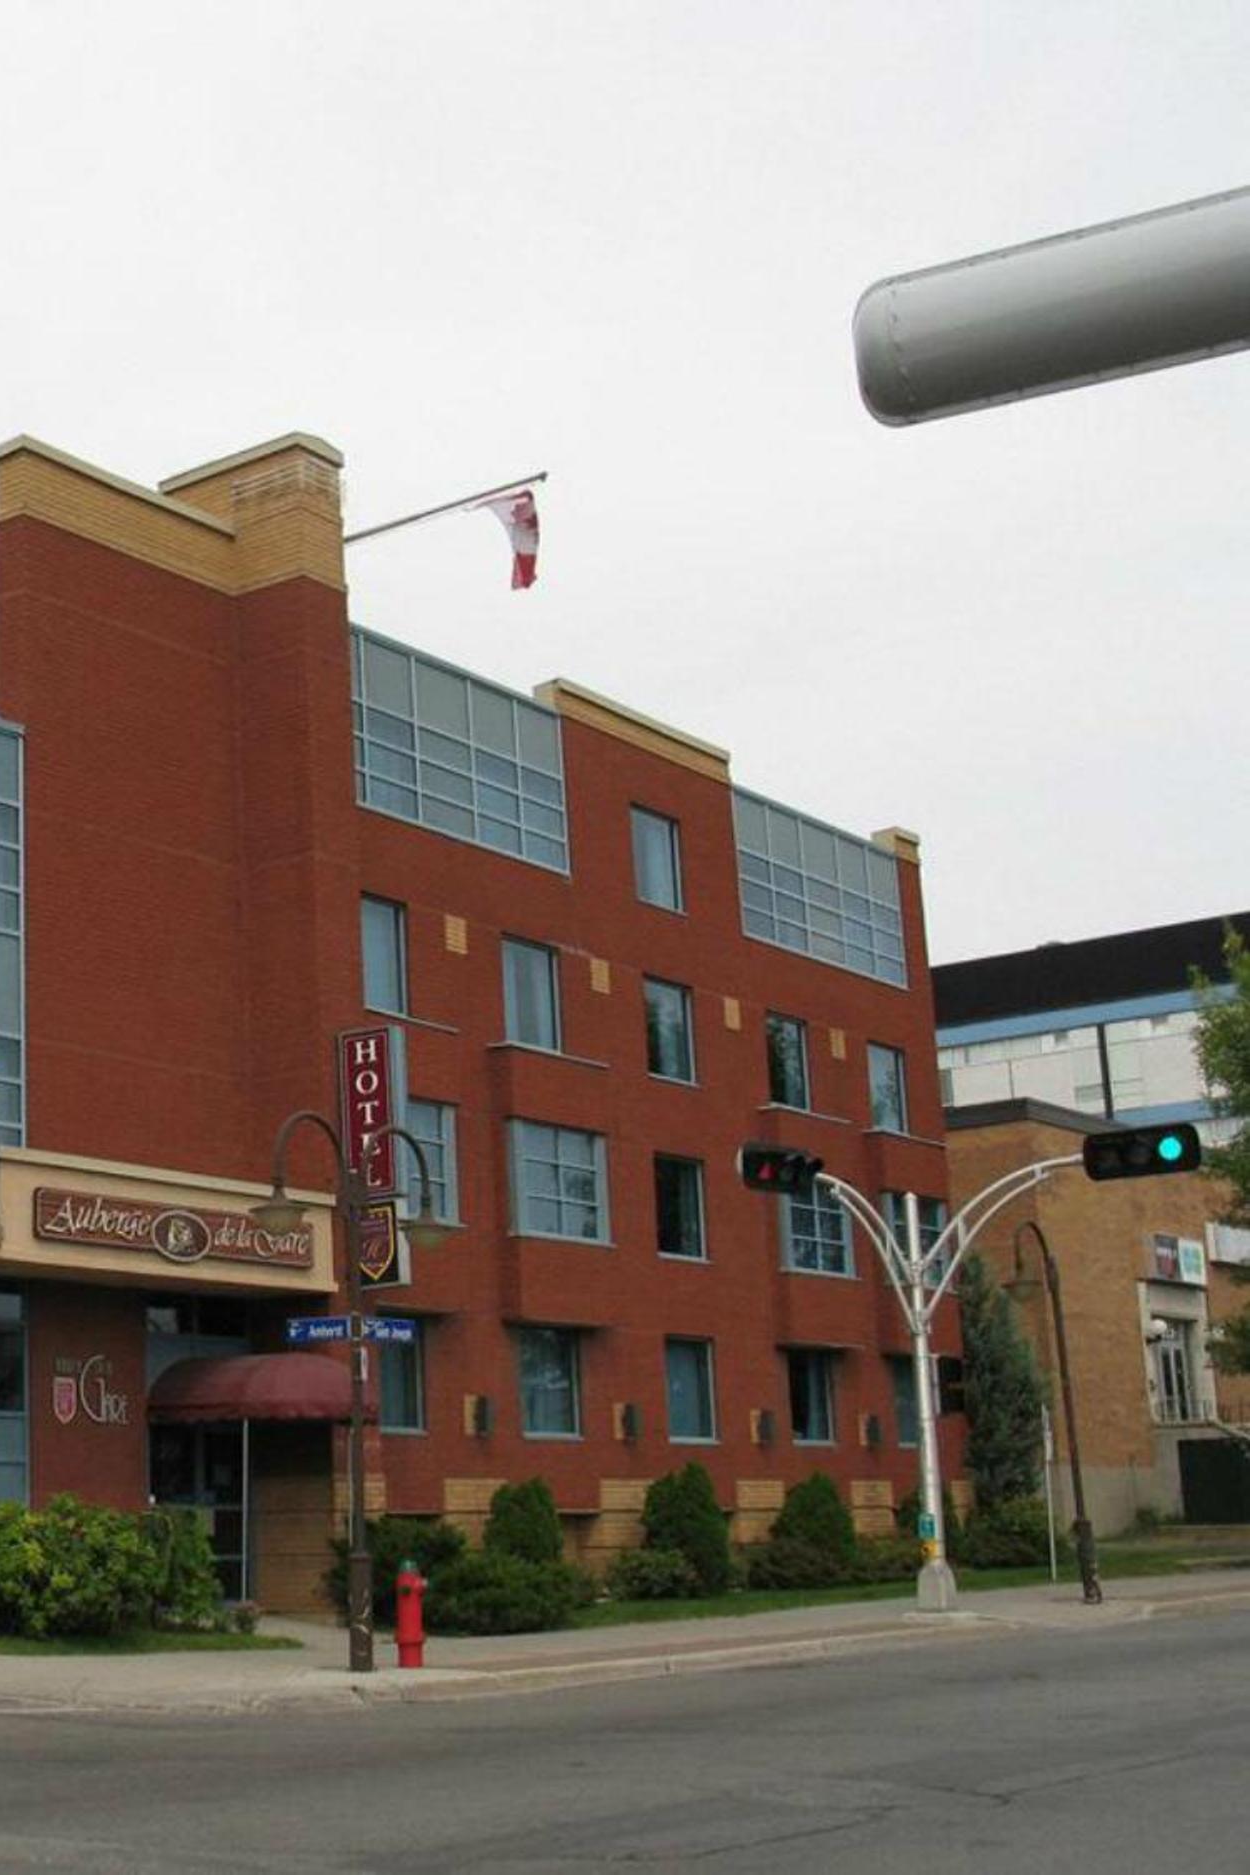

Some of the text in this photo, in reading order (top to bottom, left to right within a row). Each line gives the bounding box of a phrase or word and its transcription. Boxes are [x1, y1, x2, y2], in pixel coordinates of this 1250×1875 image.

[353, 1037, 382, 1188] HOTEL
[44, 1196, 152, 1241] Auberge
[214, 1217, 236, 1247] de
